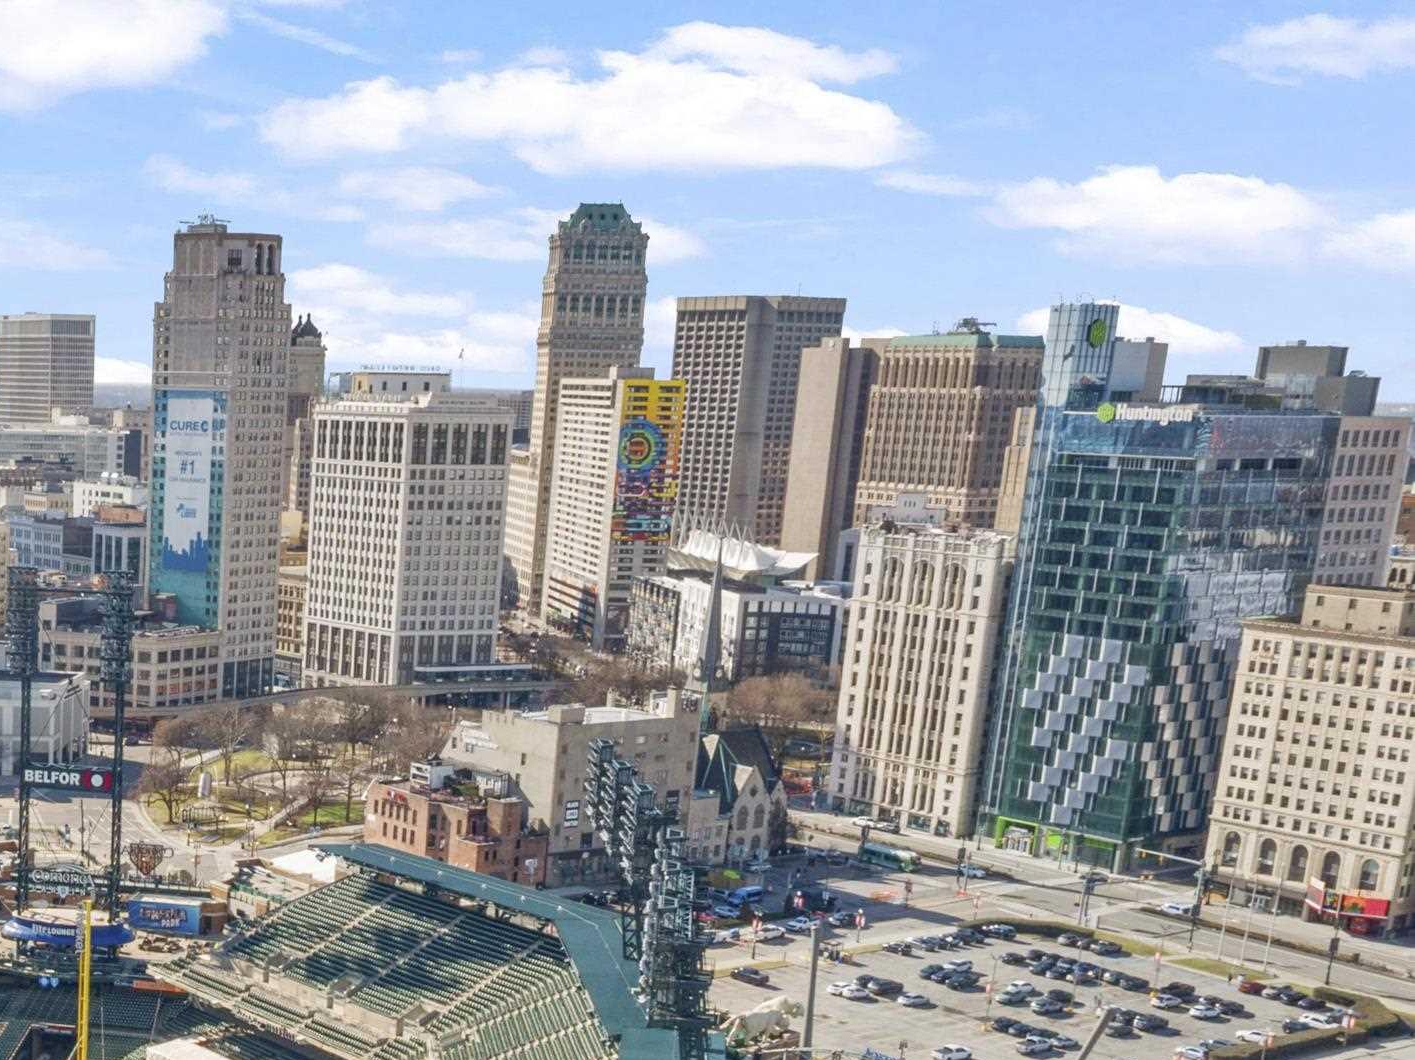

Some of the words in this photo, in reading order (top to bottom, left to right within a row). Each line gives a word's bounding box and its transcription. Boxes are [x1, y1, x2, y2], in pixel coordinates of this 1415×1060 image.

[1116, 403, 1193, 426] Huntington
[179, 459, 195, 475] #1
[24, 769, 81, 786] BELFOR
